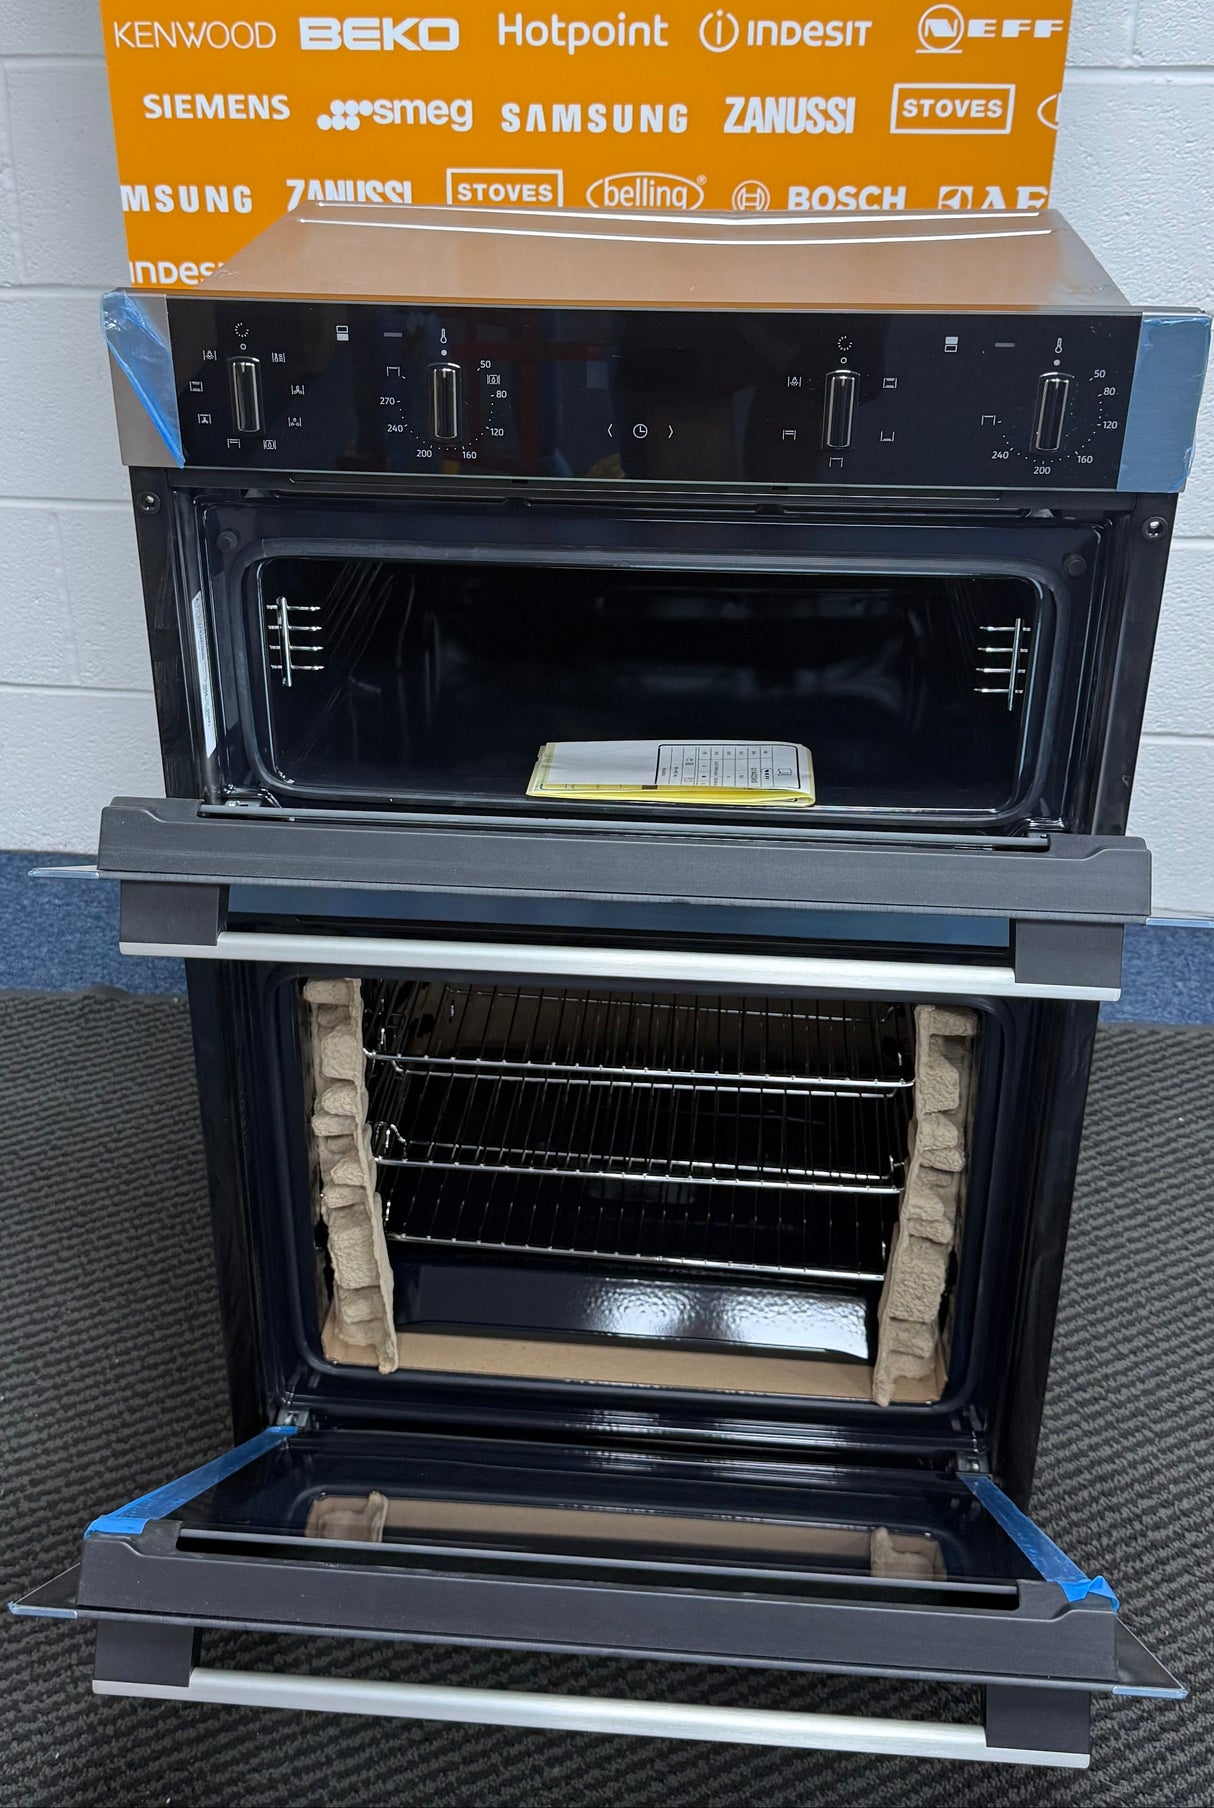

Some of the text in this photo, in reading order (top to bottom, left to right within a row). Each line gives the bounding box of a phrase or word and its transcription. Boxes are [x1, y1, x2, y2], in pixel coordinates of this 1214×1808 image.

[113, 21, 277, 49] KENWOOD
[299, 17, 460, 51] BEKO
[498, 12, 669, 55] Hotpoint
[143, 94, 291, 120] SIEMENS
[902, 98, 1003, 118] STOVES
[372, 98, 473, 132] smeg
[501, 102, 688, 134] SAMSUNG
[723, 96, 856, 134] ZANUSSI
[120, 184, 253, 214] MSUNG
[286, 179, 412, 211] ZANUSSI
[457, 183, 553, 202] STOVES
[603, 178, 688, 210] belling
[787, 185, 907, 211] BOSCH
[480, 359, 492, 369] 50
[1093, 369, 1106, 379] 50
[495, 389, 508, 399] 80
[1103, 386, 1116, 396] 80
[379, 396, 396, 406] 270
[387, 423, 404, 433] 240
[490, 427, 505, 437] 120
[1102, 420, 1118, 430] 120
[416, 449, 433, 459] 200
[462, 450, 478, 460] 160
[991, 450, 1010, 460] 240
[1077, 455, 1094, 465] 160
[1033, 466, 1051, 475] 200
